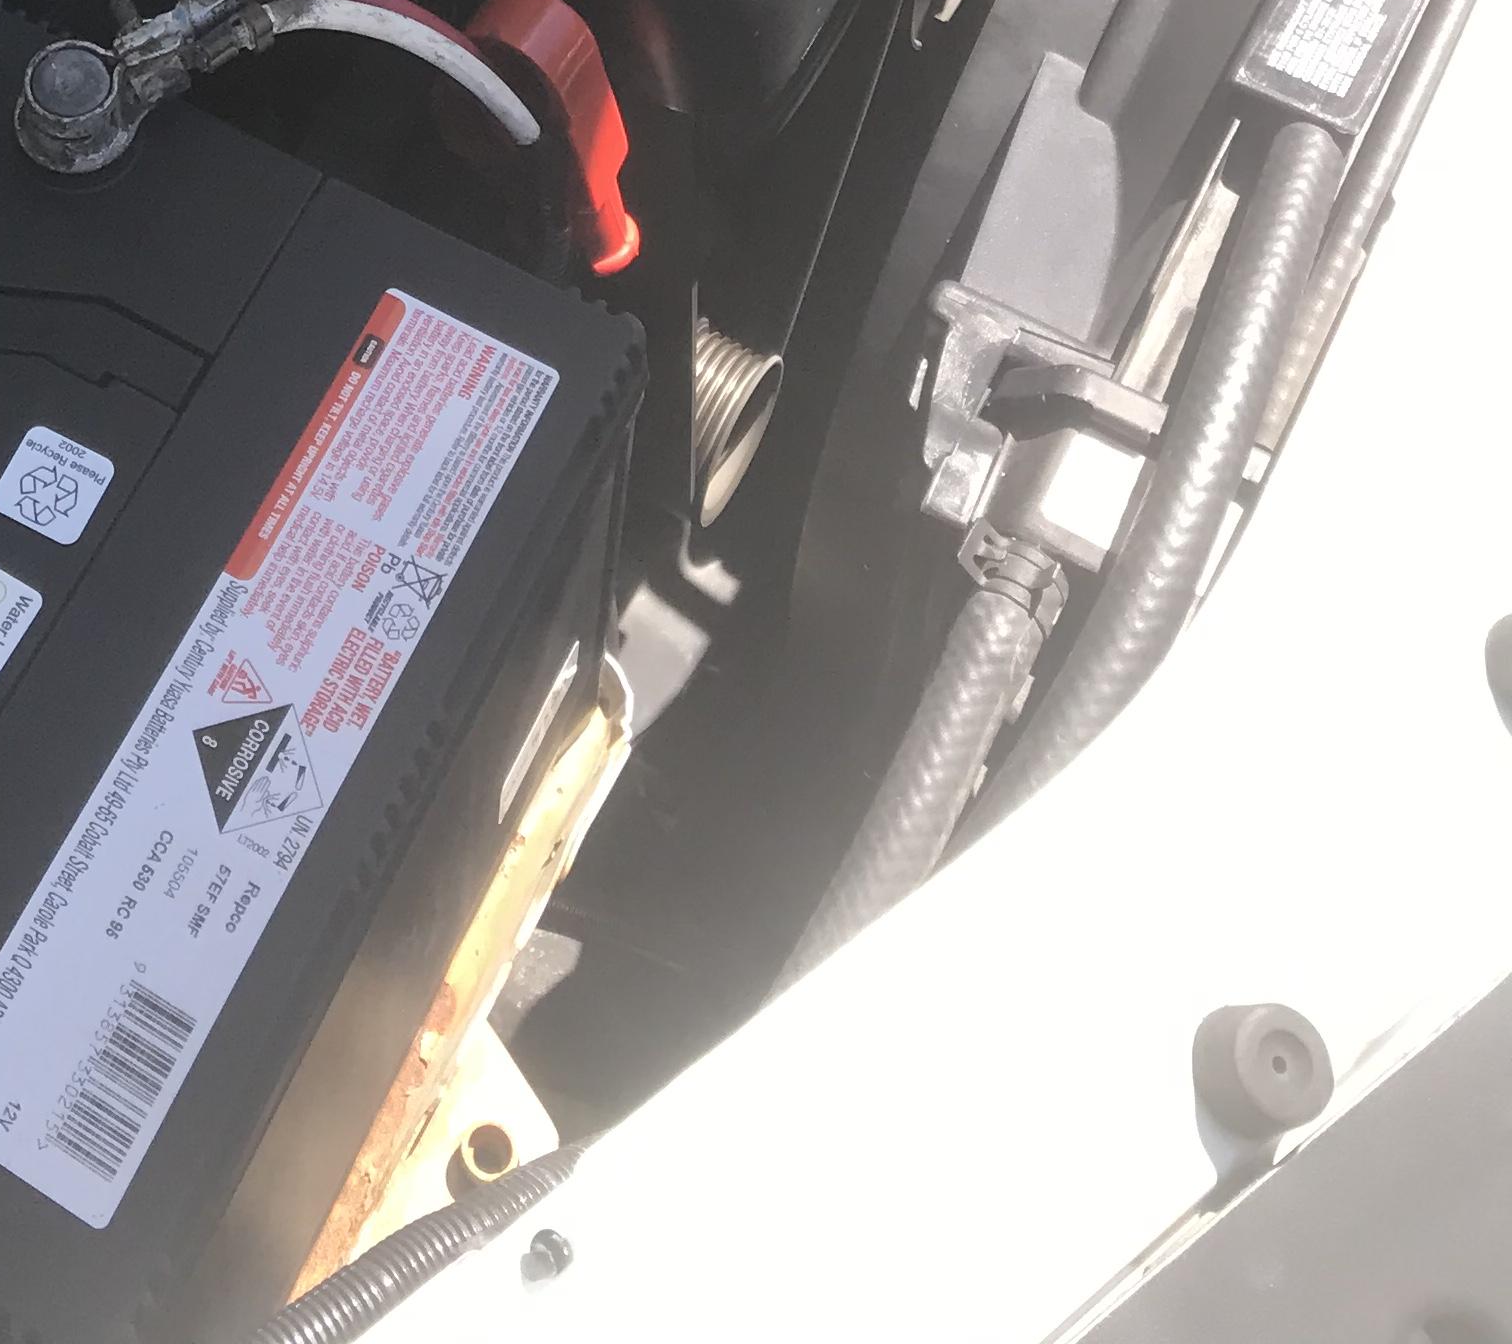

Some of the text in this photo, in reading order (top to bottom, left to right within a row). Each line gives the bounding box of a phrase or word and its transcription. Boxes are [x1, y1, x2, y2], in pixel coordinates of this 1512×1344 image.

[456, 342, 497, 401] WARNING
[26, 438, 106, 486] Please Recycle
[58, 439, 87, 459] 2002
[349, 542, 386, 593] POISON
[379, 551, 402, 577] Pb
[205, 576, 248, 628] Supplied
[196, 618, 224, 644] by:
[173, 635, 215, 683] Century
[326, 625, 367, 682] ELECTRIC
[159, 675, 192, 714] Yuasa
[320, 635, 384, 734] FILLED WITH ACID
[133, 706, 175, 758] Batteries
[199, 732, 219, 750] 8
[120, 749, 149, 777] Pty
[213, 715, 272, 803] CORROSIVE
[112, 769, 139, 796] Ltd
[94, 788, 128, 828] 49-65
[74, 819, 110, 862] Cobalt
[145, 827, 175, 866] CCA
[271, 835, 301, 872] 2794
[33, 890, 70, 934] Carole
[114, 893, 138, 921] RC
[183, 901, 212, 939] SMF
[220, 877, 262, 937] Repco
[11, 952, 34, 972] Q
[18, 925, 49, 961] Park
